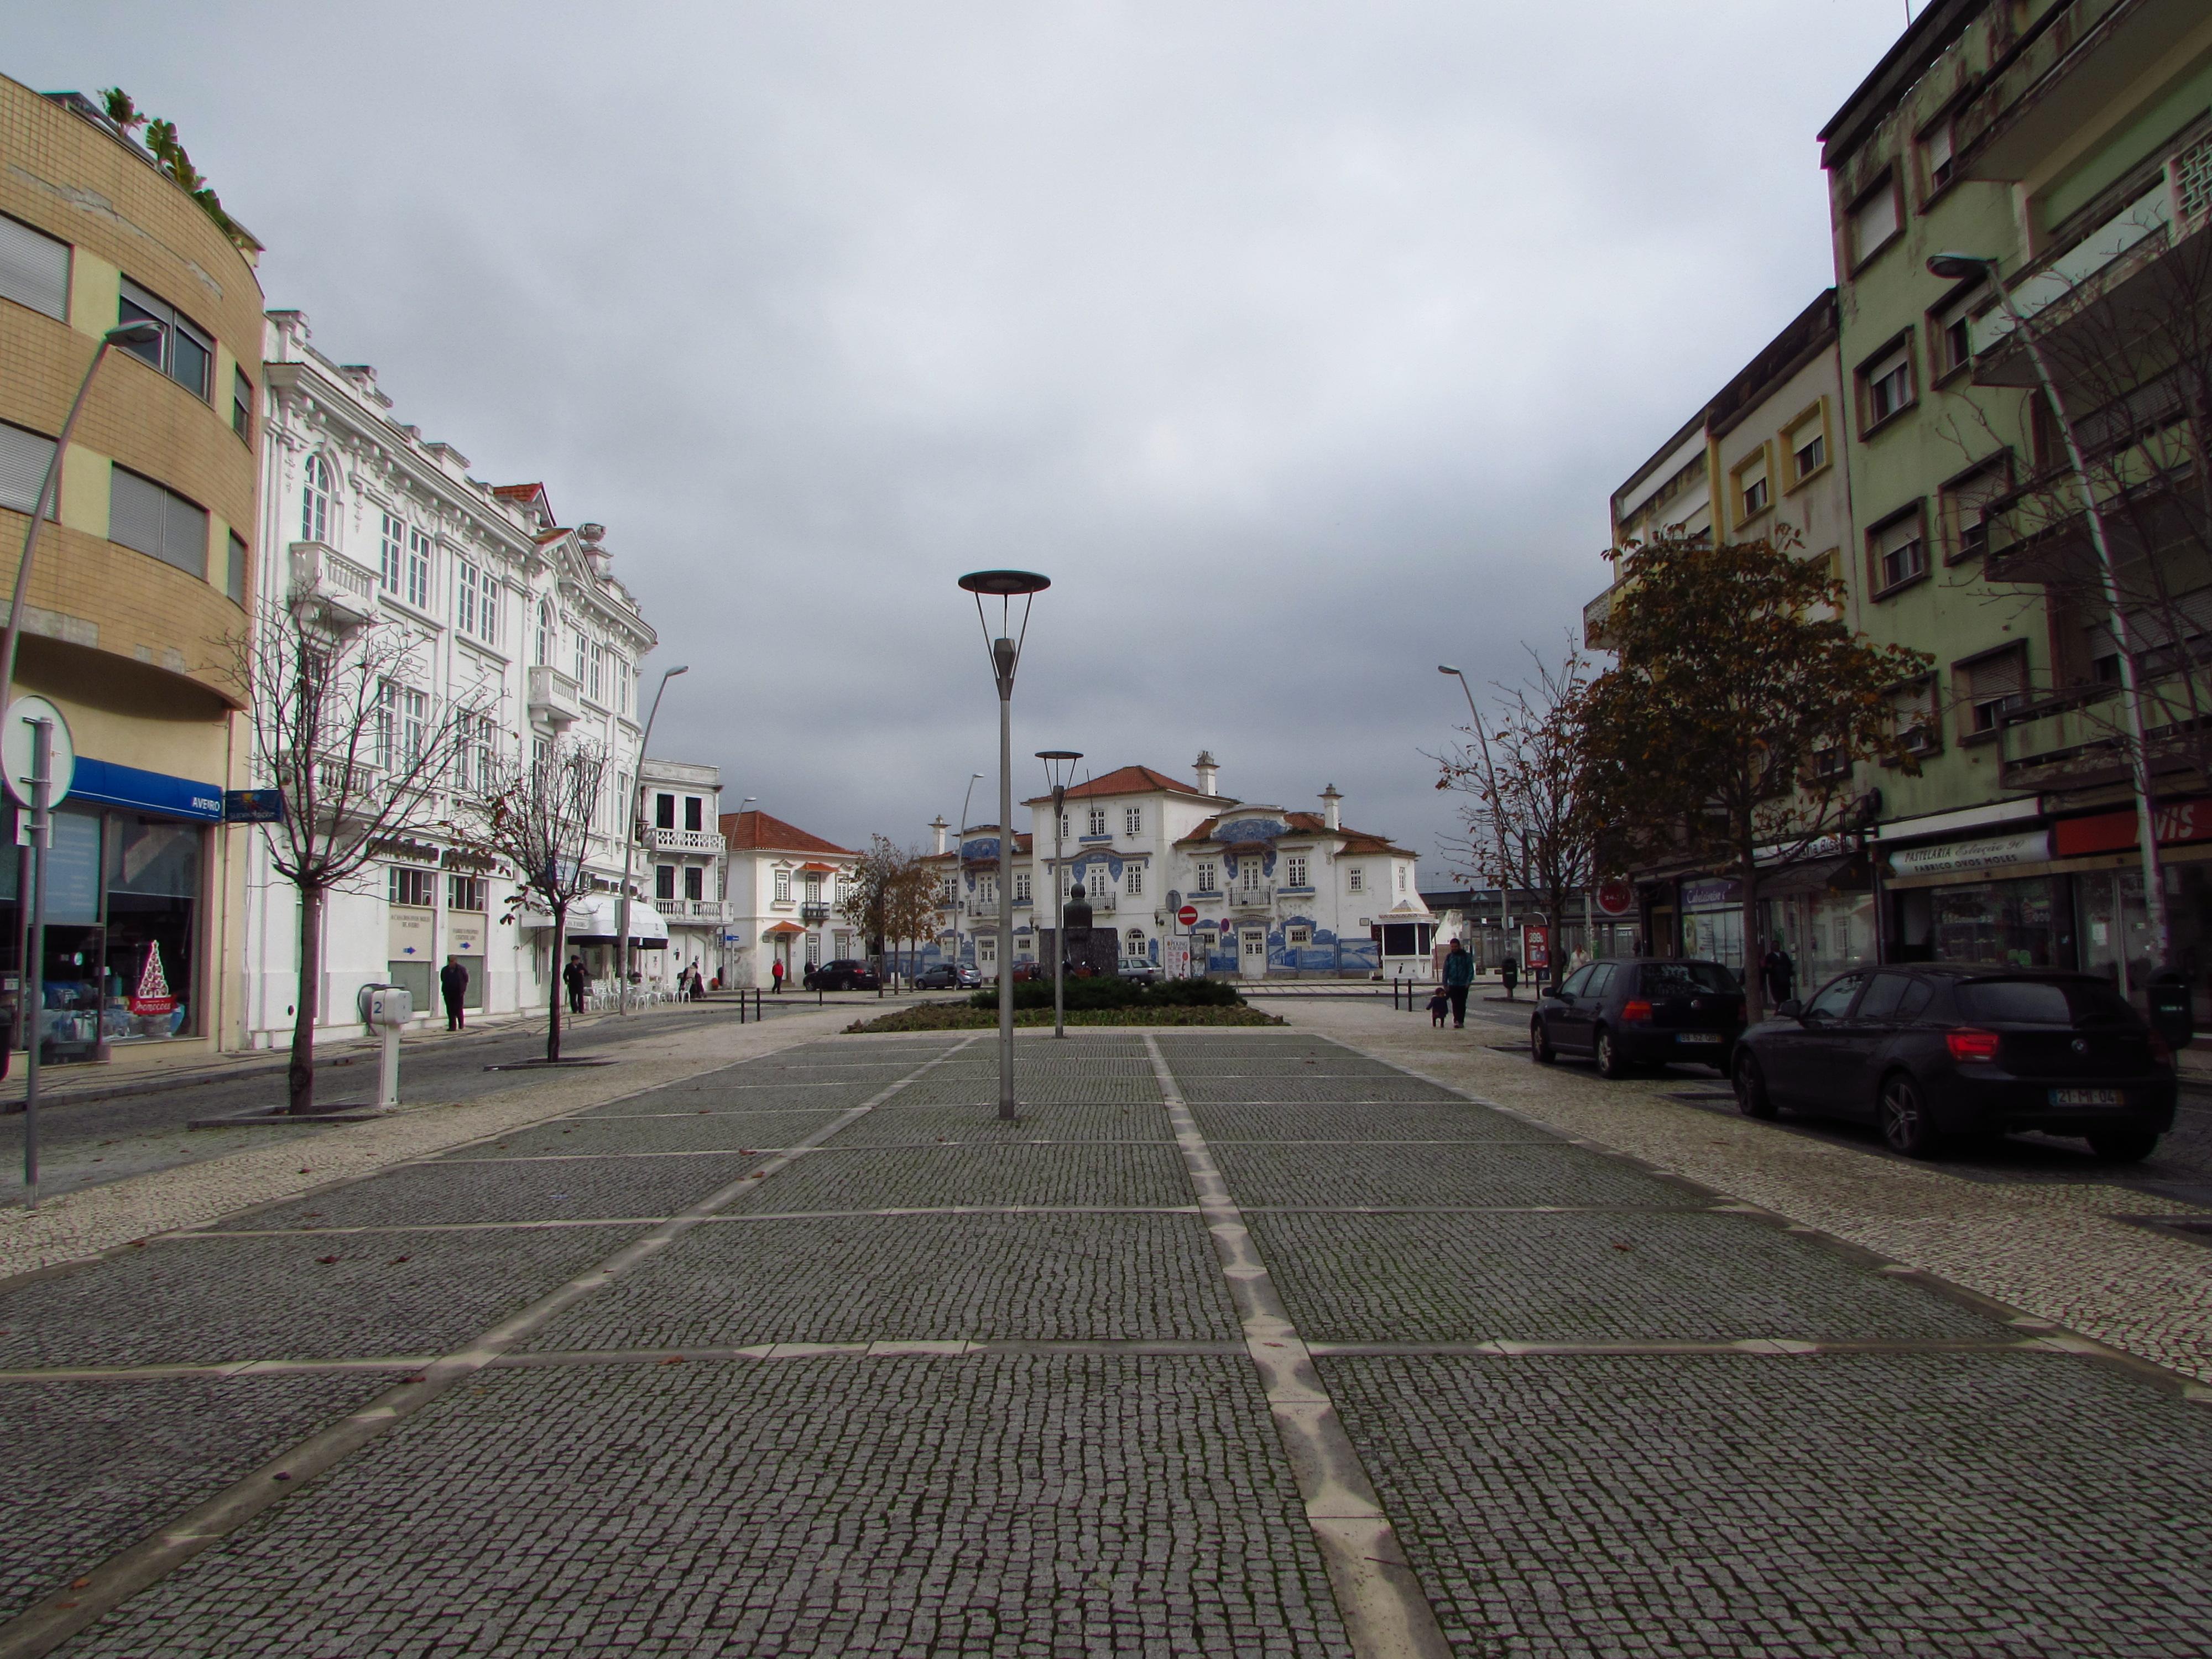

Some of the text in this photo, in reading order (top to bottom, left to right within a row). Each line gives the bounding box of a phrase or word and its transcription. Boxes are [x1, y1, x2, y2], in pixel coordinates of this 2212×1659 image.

[192, 797, 220, 811] AVEIRO
[2134, 804, 2194, 843] VIS
[1904, 848, 1951, 863] PASTELARIA
[1954, 842, 2002, 857] Estação
[1914, 854, 2017, 873] FABRICO OVOS MOLES
[374, 1001, 382, 1014] 2
